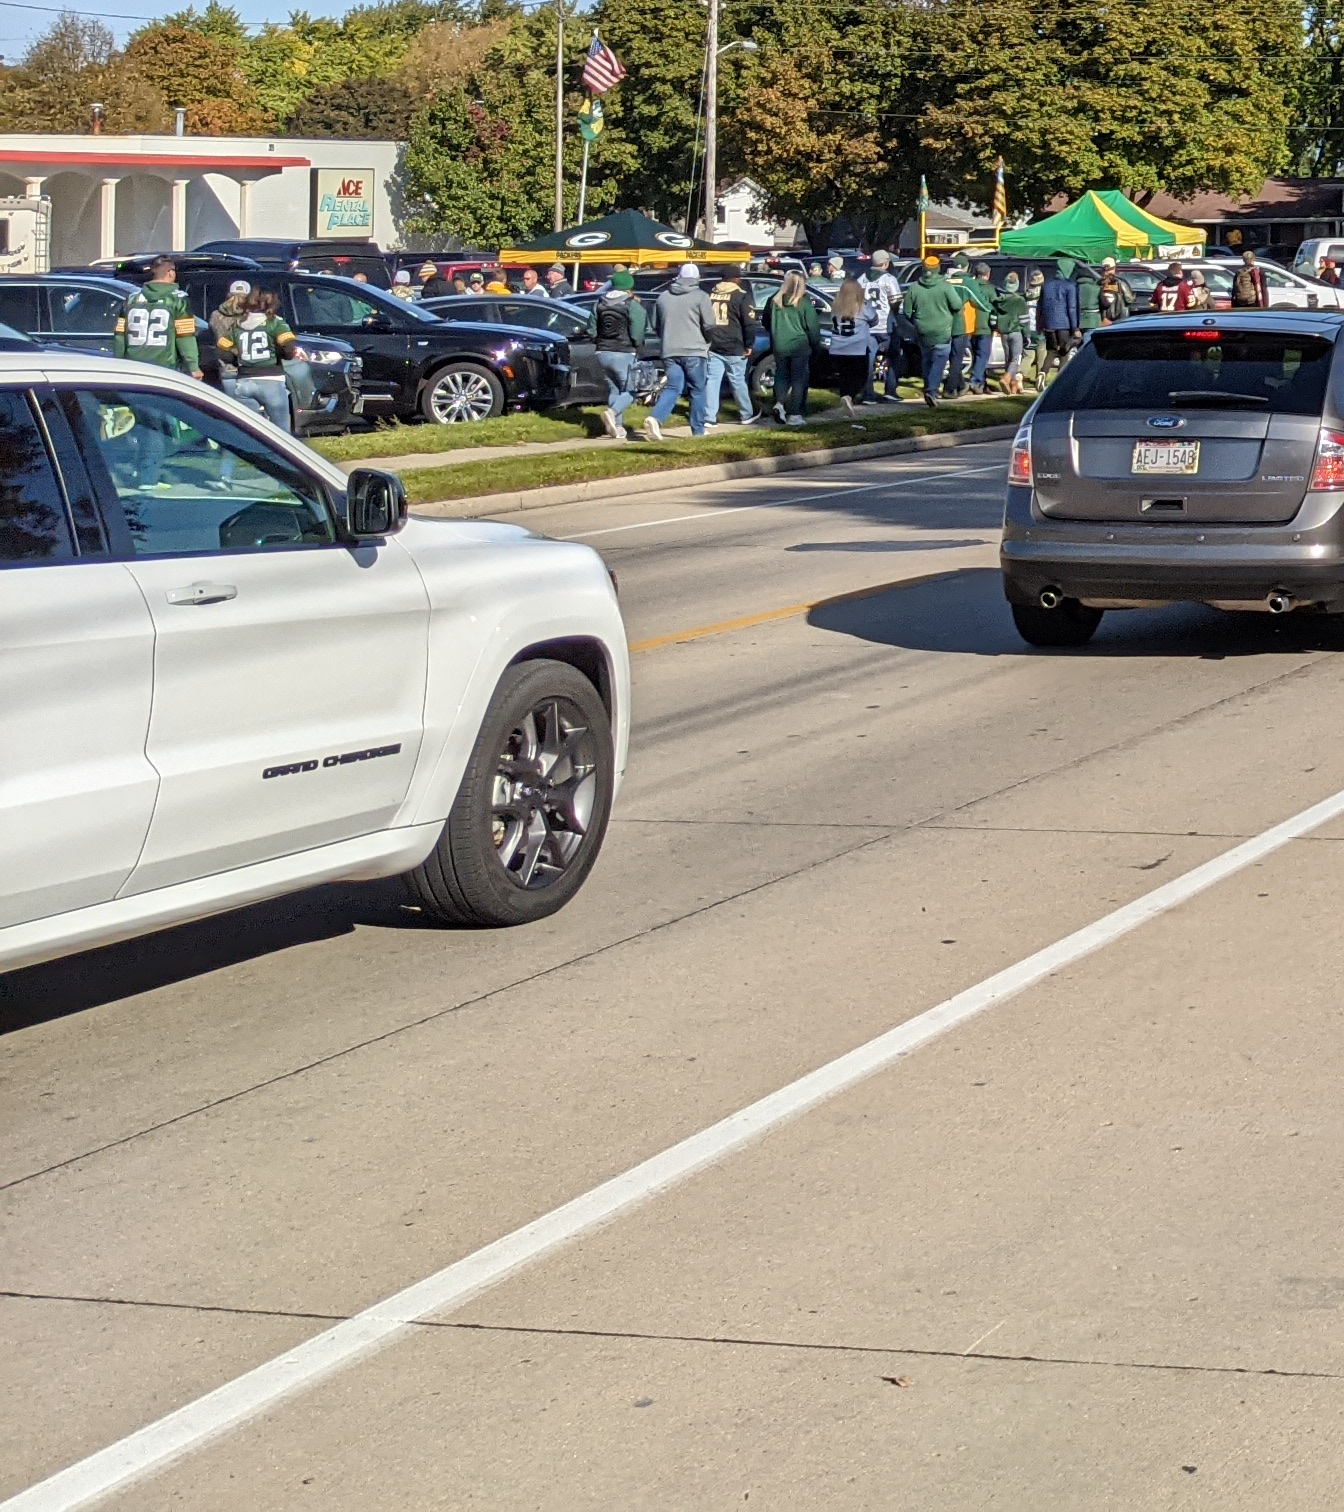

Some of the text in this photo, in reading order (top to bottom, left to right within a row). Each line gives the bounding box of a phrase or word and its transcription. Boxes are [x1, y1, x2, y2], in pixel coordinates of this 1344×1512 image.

[336, 177, 364, 196] ACE
[319, 193, 369, 212] RENTAL
[326, 212, 371, 230] PLACE
[1160, 292, 1179, 311] 17
[127, 308, 170, 346] 92
[239, 330, 271, 361] 12
[262, 742, 402, 779] GRAND CHEROKEE
